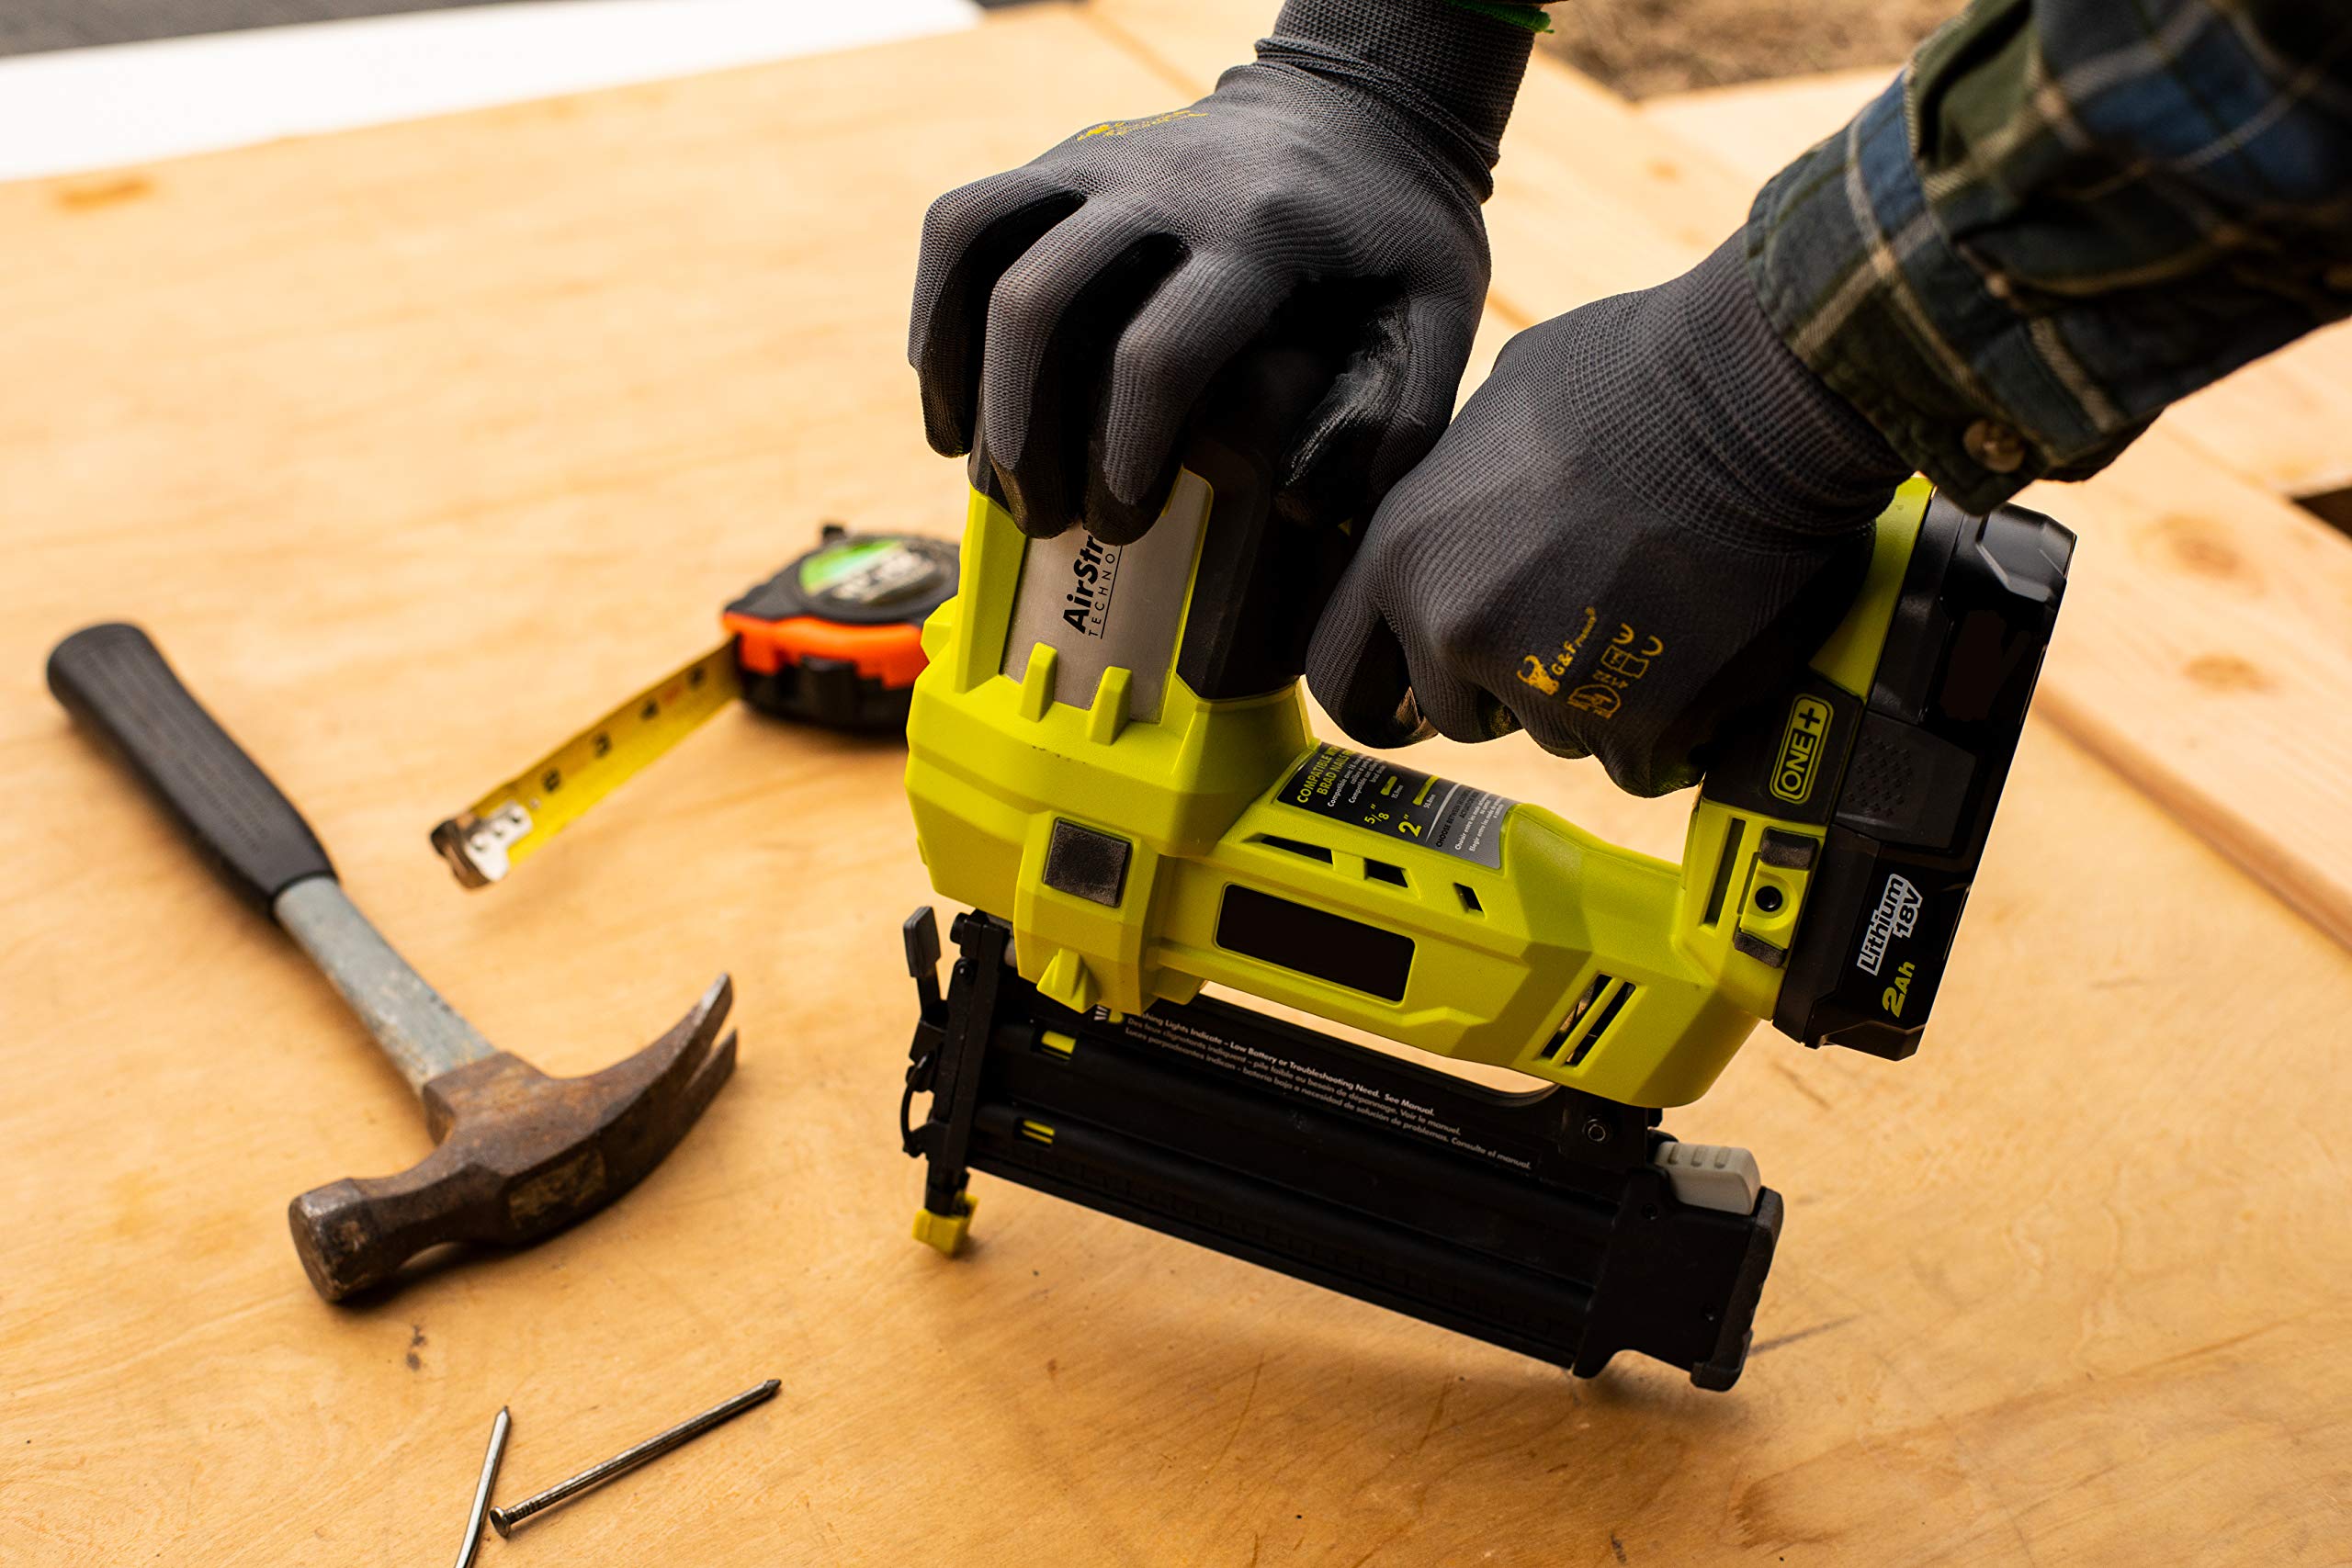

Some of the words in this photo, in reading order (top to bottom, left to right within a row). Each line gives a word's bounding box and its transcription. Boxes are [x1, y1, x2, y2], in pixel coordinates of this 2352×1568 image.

[1063, 535, 1103, 634] AirStr
[1088, 553, 1115, 636] TECHNO
[1297, 755, 1332, 803] COMPATIBLE
[1317, 772, 1338, 795] BRAD
[1329, 754, 1351, 773] NAILS
[1327, 778, 1348, 807] Compatible
[1436, 824, 1453, 848] CHOOSE
[1454, 832, 1467, 851] Choisir
[1858, 875, 1907, 975] Lithium
[1894, 886, 1921, 937] 18V
[1882, 961, 1916, 1019] 2Ah
[1165, 1020, 1189, 1033] Lights
[1190, 1028, 1223, 1044] Indicate
[1230, 1042, 1247, 1053] Low
[1248, 1047, 1277, 1064] Battery
[1290, 1061, 1354, 1090] Troubleshooting
[1355, 1084, 1380, 1098] Need.
[1385, 1093, 1400, 1104] See
[1400, 1099, 1434, 1116] Manual.
[1205, 1055, 1236, 1070] indican
[1273, 1077, 1293, 1089] baja
[1301, 1089, 1343, 1106] necesidad
[1343, 1101, 1355, 1110] de
[1391, 1117, 1402, 1125] de
[1402, 1122, 1449, 1142] problemas.
[1451, 1137, 1487, 1154] Consulte
[1497, 1154, 1531, 1169] manual.
[1253, 1062, 1269, 1071] pile
[1271, 1066, 1294, 1079] faible
[1307, 1077, 1335, 1093] besoin
[1336, 1089, 1347, 1097] de
[1400, 1109, 1417, 1120] Voir
[1418, 1115, 1426, 1123] le
[1427, 1120, 1461, 1135] manuel.
